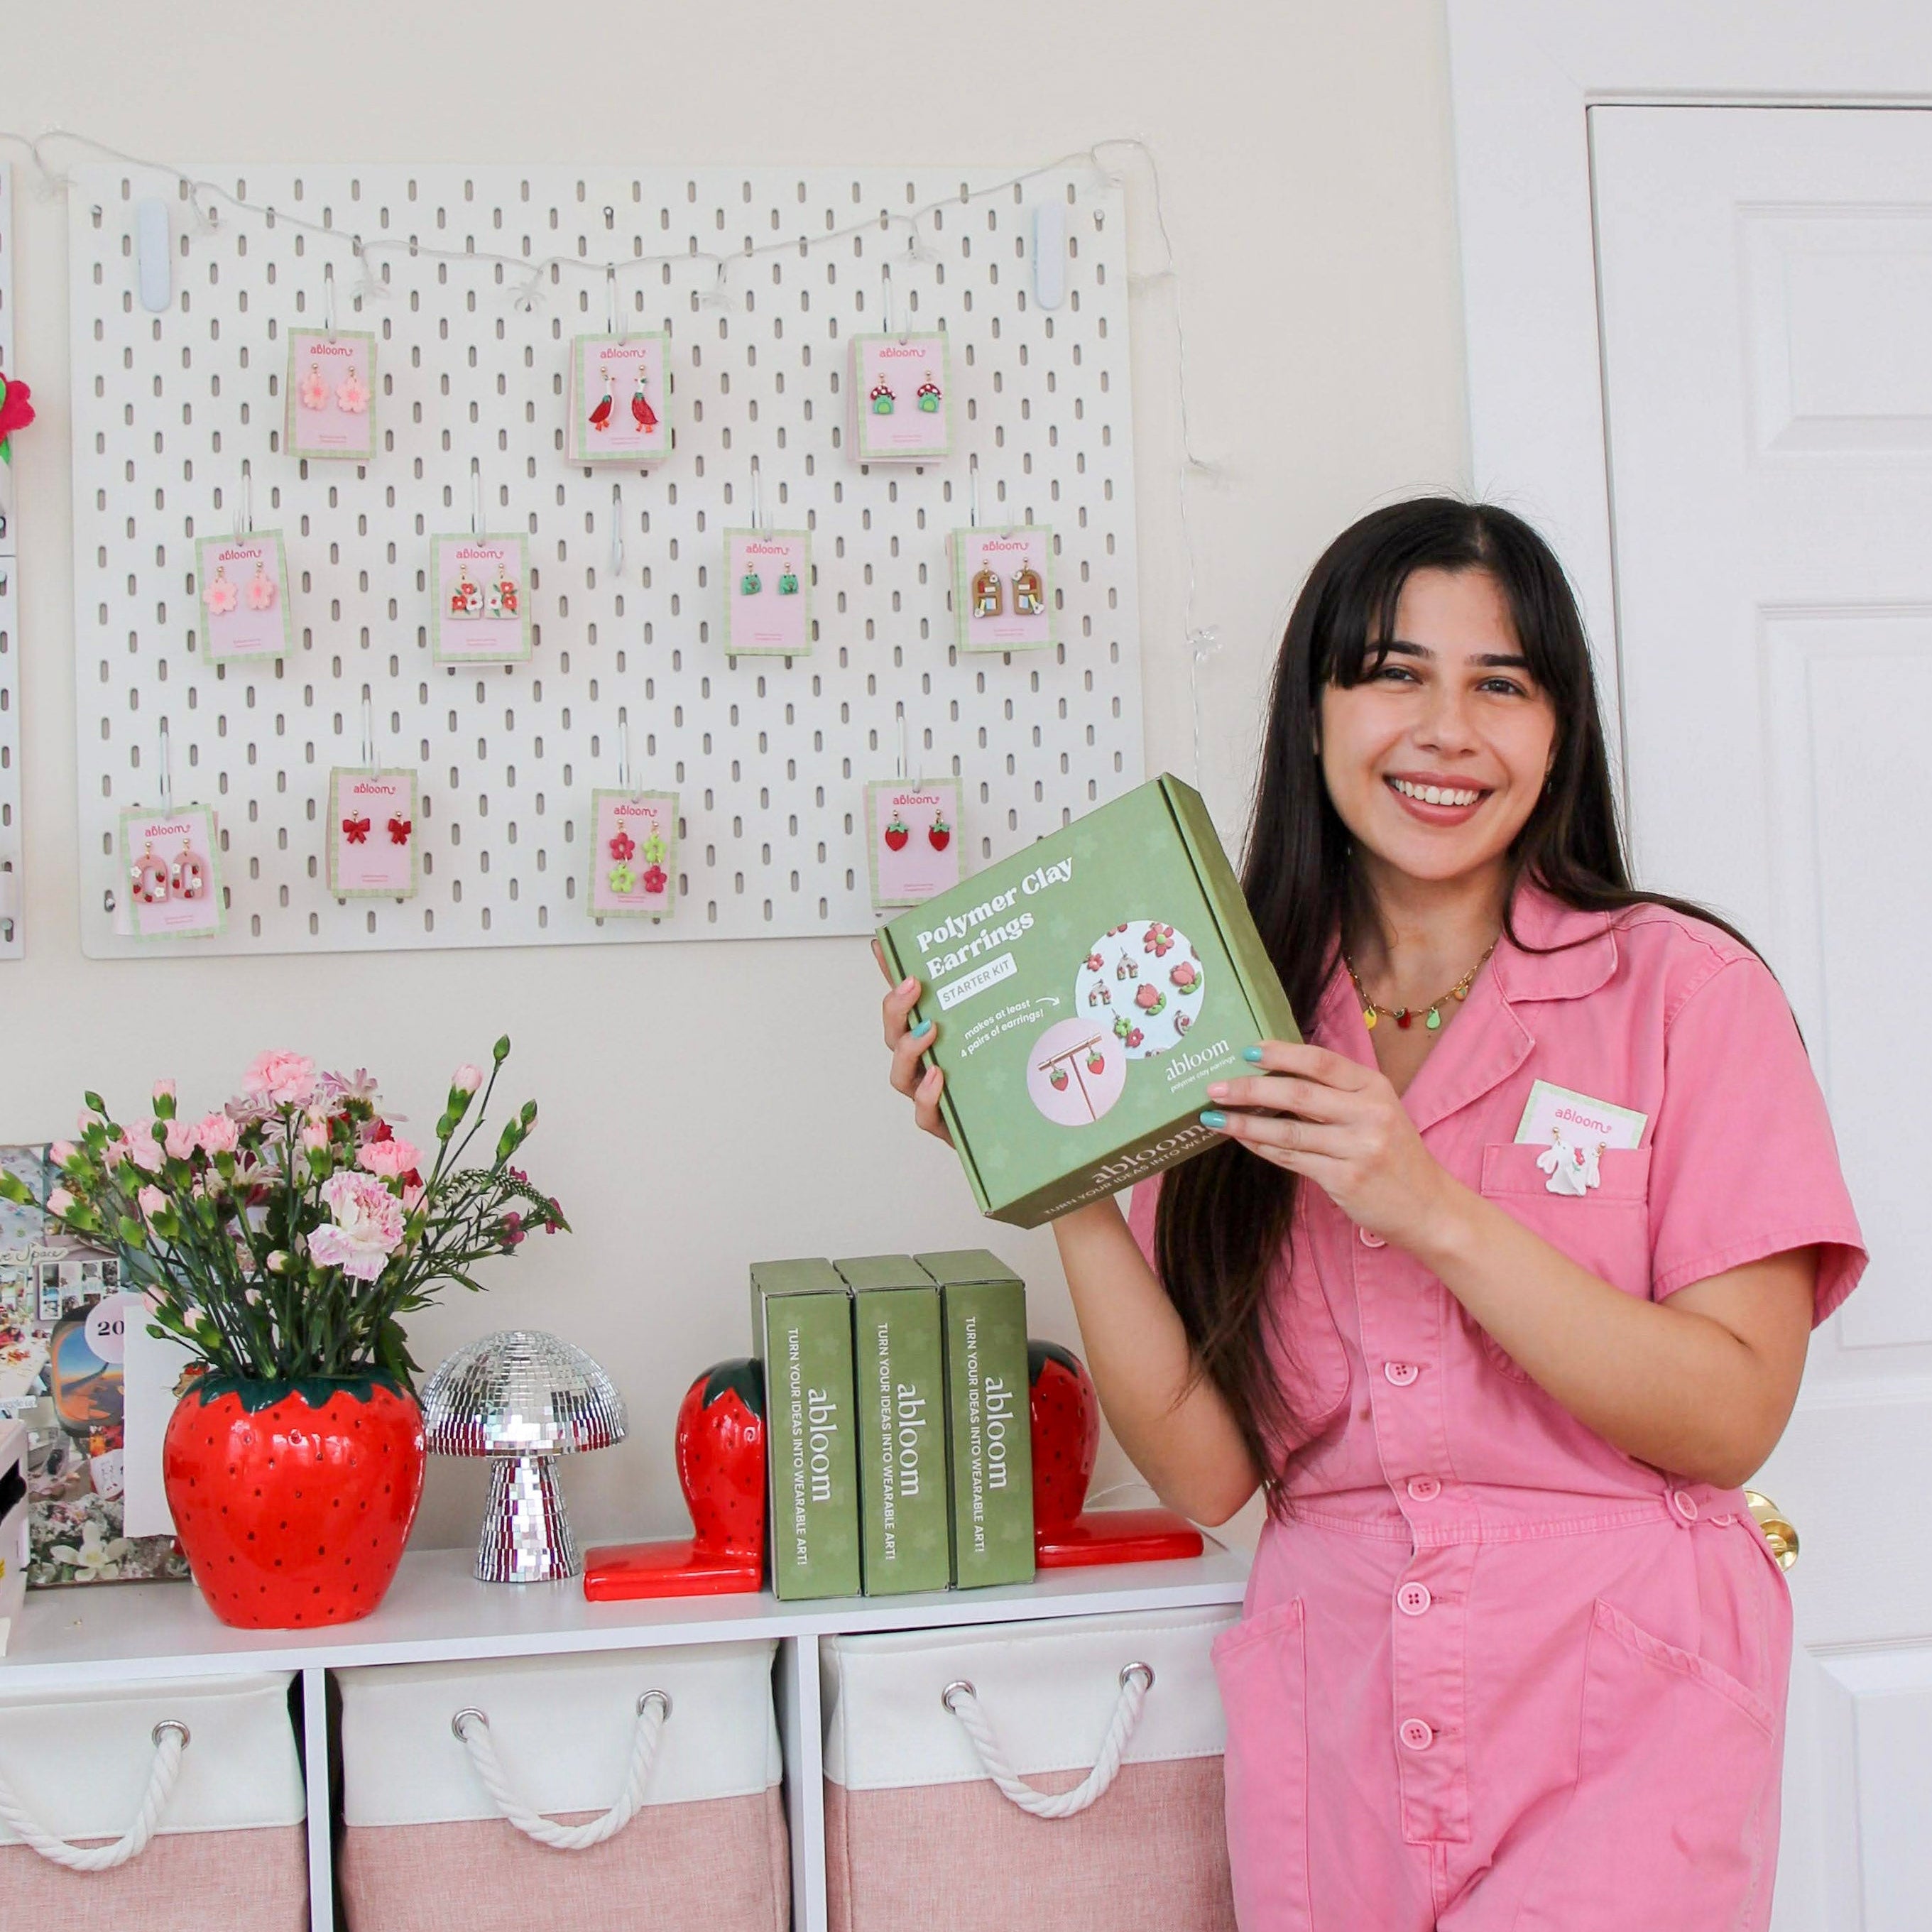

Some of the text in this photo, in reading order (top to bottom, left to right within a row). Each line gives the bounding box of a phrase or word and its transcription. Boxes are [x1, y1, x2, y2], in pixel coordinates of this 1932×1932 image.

[917, 857, 1072, 953] Polymer Clay
[926, 912, 1035, 980] Earrings
[943, 960, 1009, 1003] STARTER KIT
[961, 1008, 1044, 1057] 4 pairs of earrings!
[964, 1000, 1030, 1040] makes at least
[1165, 1039, 1230, 1081] abloom
[1170, 1055, 1235, 1093] polymer clay earrings
[1044, 1199, 1076, 1215] TURN
[1077, 1182, 1112, 1200] YOUR
[1113, 1164, 1150, 1184] IDEAS
[1150, 1149, 1180, 1166] INTO
[1092, 1125, 1206, 1184] abloom
[788, 1328, 807, 1565] TURN YOUR IDEAS INTO WEARABLE ART!
[808, 1388, 838, 1502] abloom
[878, 1323, 895, 1560] TURN YOUR IDEAS INTO WEARABLE ART!
[897, 1383, 927, 1496] abloom
[966, 1316, 985, 1552] TURN YOUR IDEAS INTO WEARABLE ART!
[985, 1377, 1014, 1490] abloom
